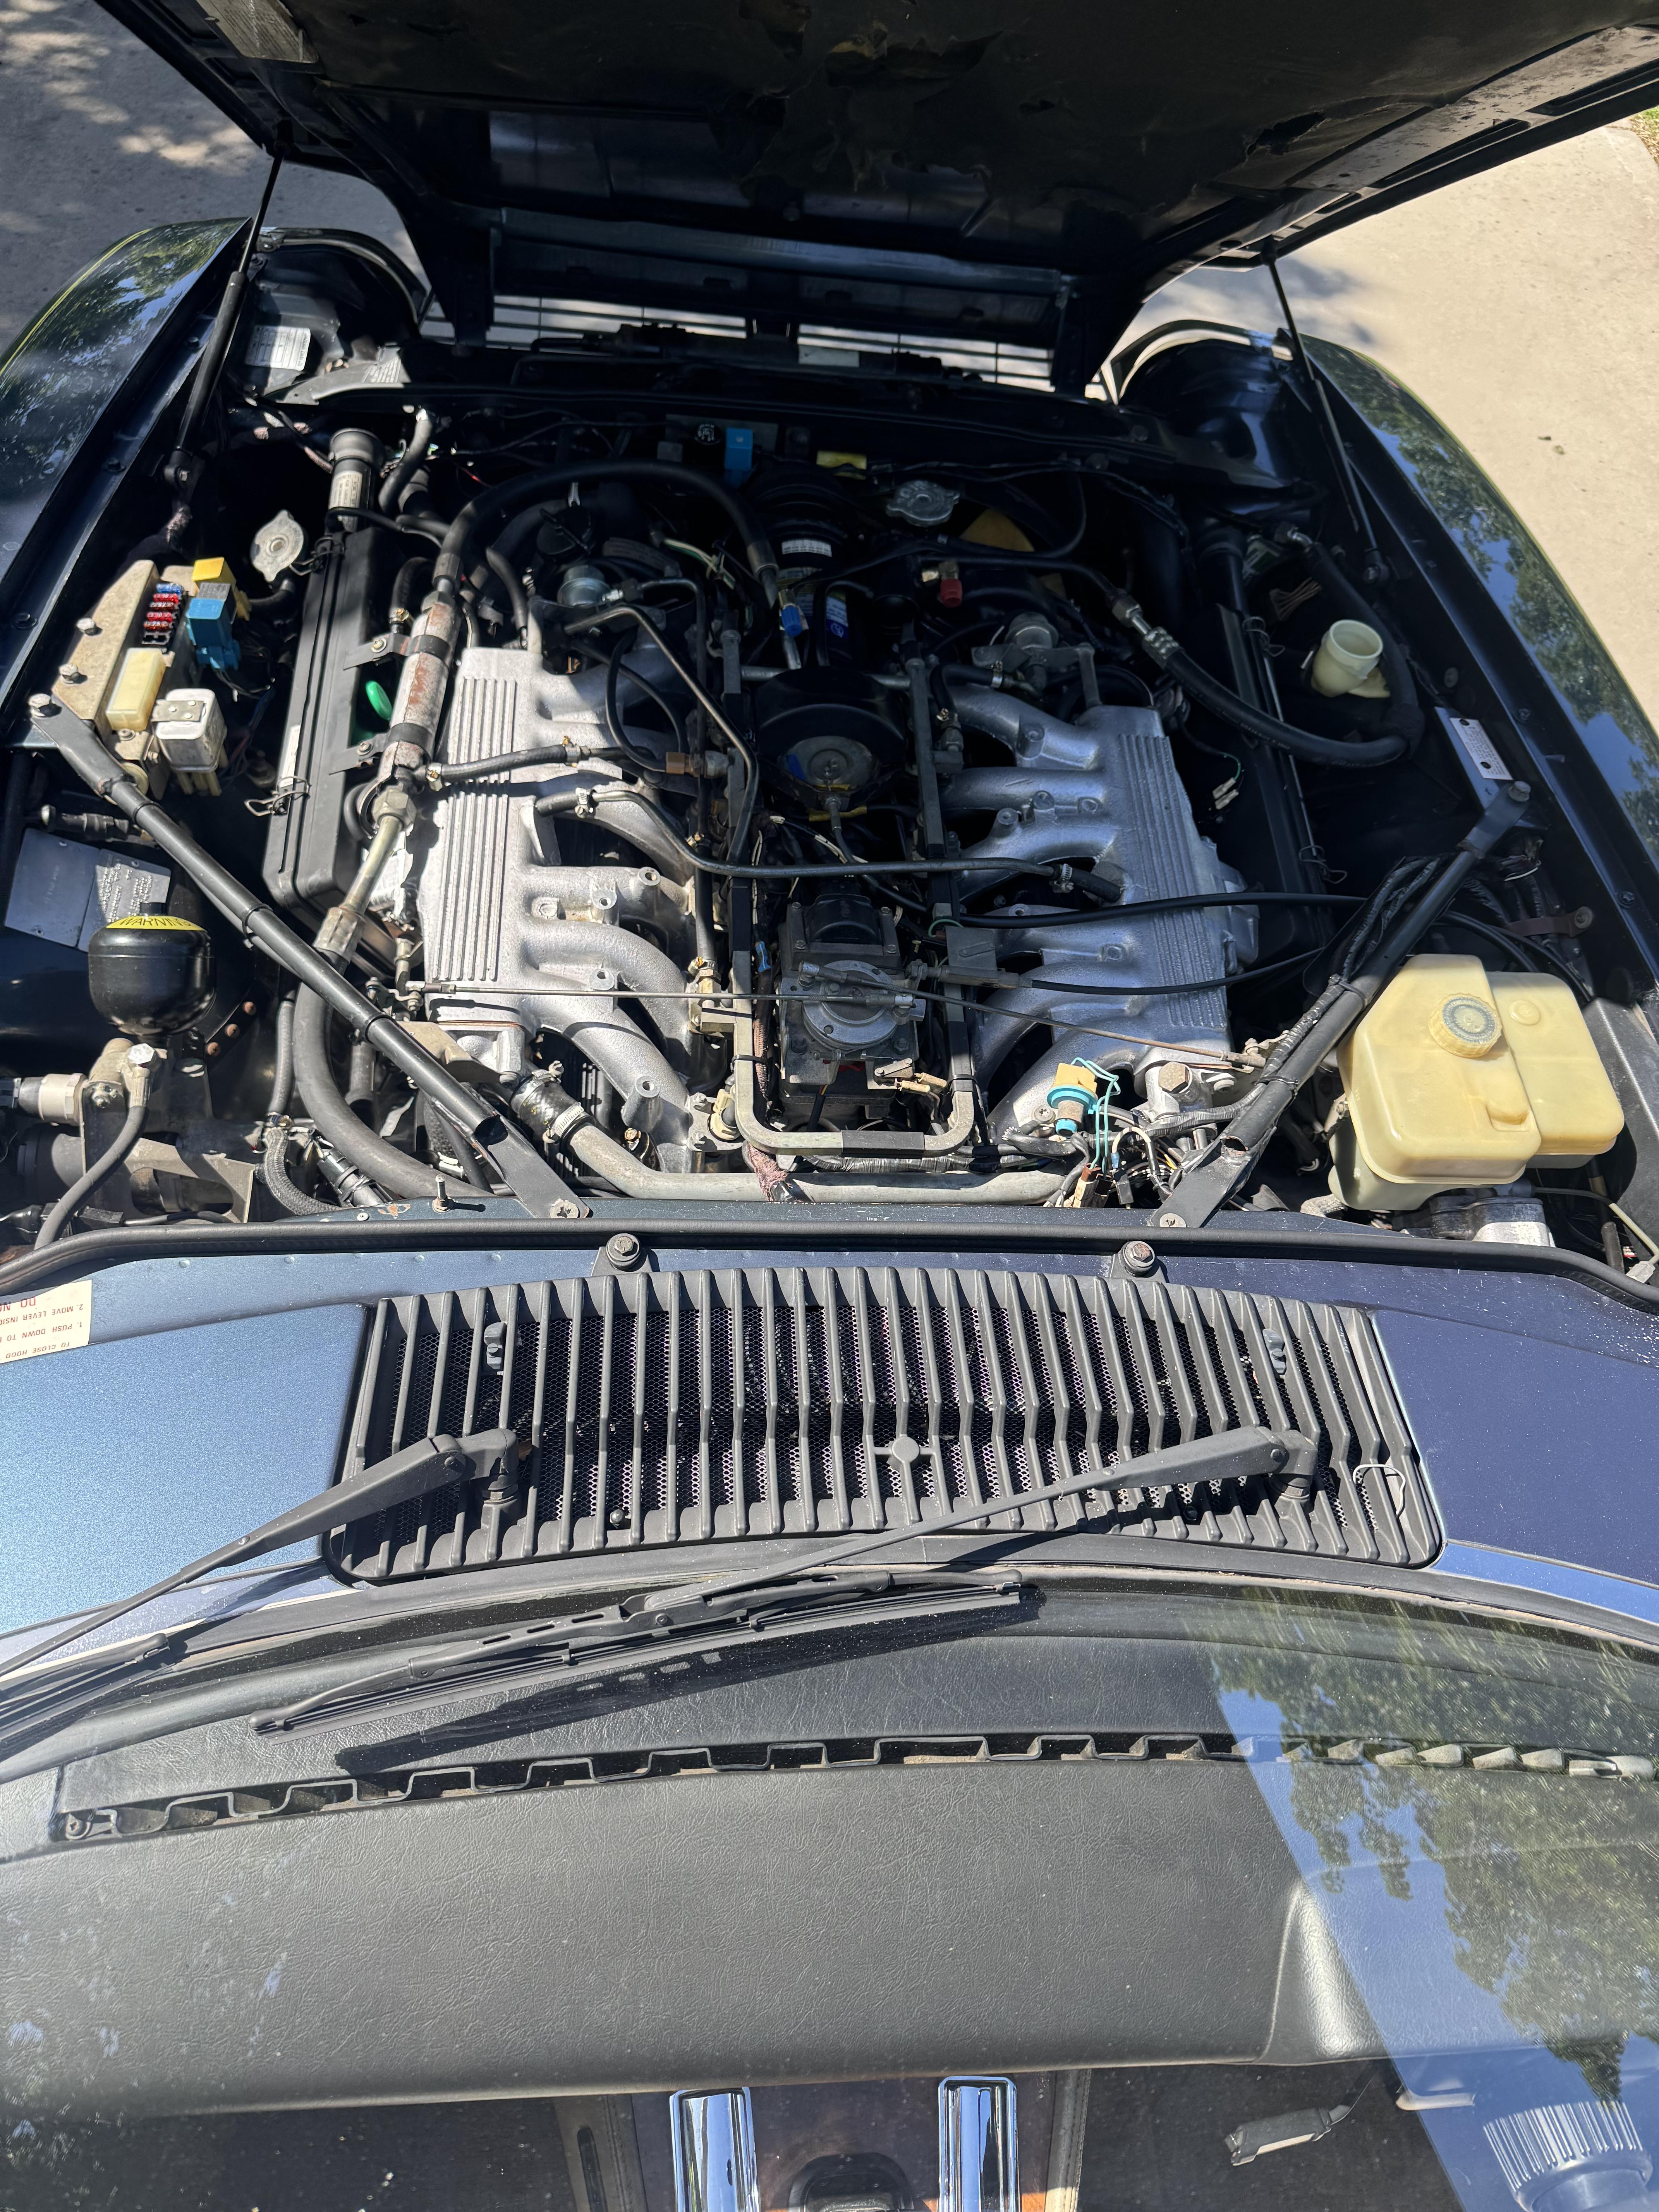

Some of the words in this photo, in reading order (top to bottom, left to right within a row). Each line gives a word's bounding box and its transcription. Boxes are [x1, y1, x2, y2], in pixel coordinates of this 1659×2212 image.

[52, 1306, 74, 1315] MOVE
[23, 1311, 46, 1321] LEVER
[52, 1324, 72, 1333] PUSH
[22, 1329, 46, 1338] DOWN
[32, 1345, 56, 1353] CLOSE
[6, 1350, 27, 1358] HOOD
